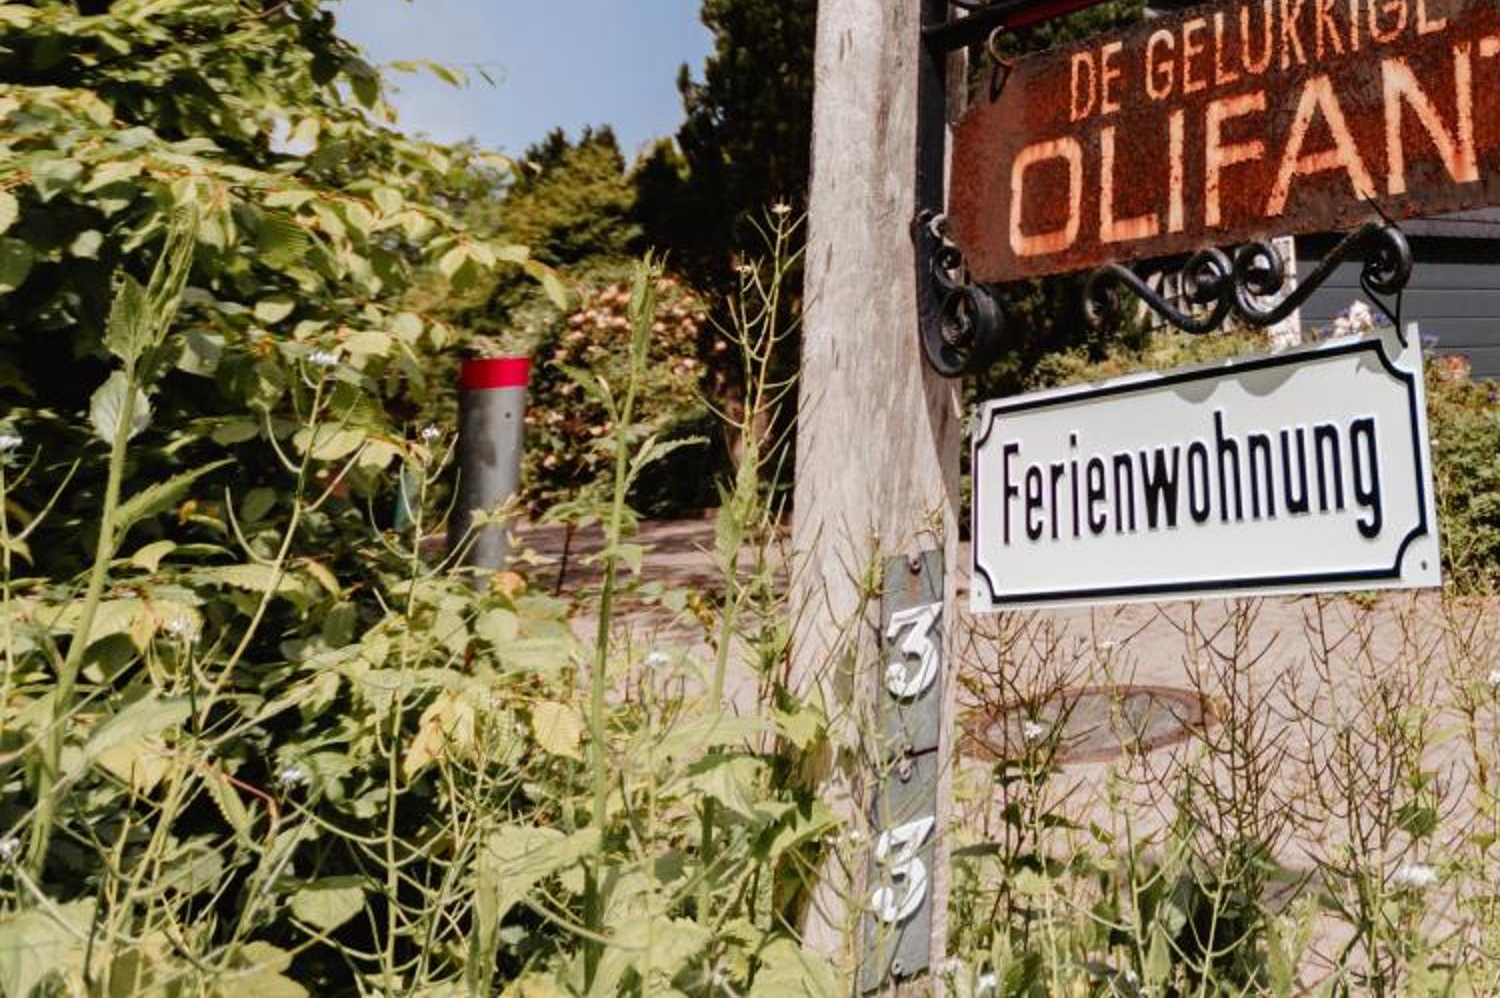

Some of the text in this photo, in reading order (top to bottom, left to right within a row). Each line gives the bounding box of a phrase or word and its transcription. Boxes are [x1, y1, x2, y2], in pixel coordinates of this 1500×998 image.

[1070, 40, 1123, 122] DE
[1004, 411, 1383, 544] Ferienwohnung
[885, 602, 943, 698] 3
